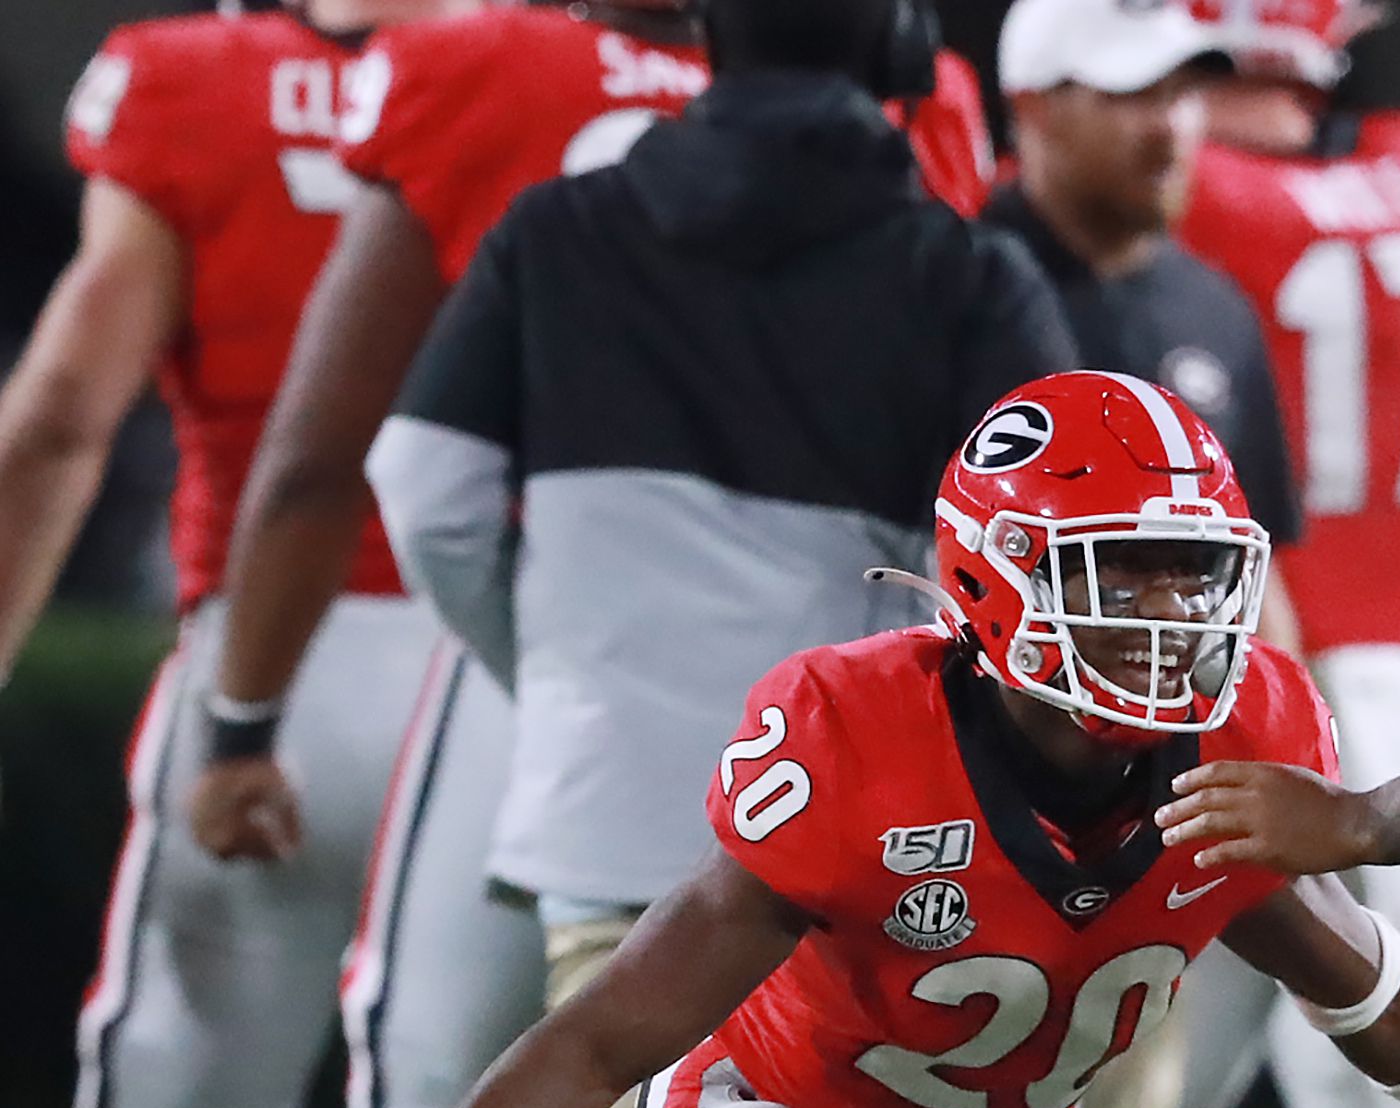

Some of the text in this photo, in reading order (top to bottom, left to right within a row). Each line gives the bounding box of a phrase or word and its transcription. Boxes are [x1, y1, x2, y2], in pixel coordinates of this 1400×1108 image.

[962, 402, 1053, 474] G
[719, 704, 813, 842] 20
[884, 822, 973, 873] 150
[903, 883, 962, 933] SEC
